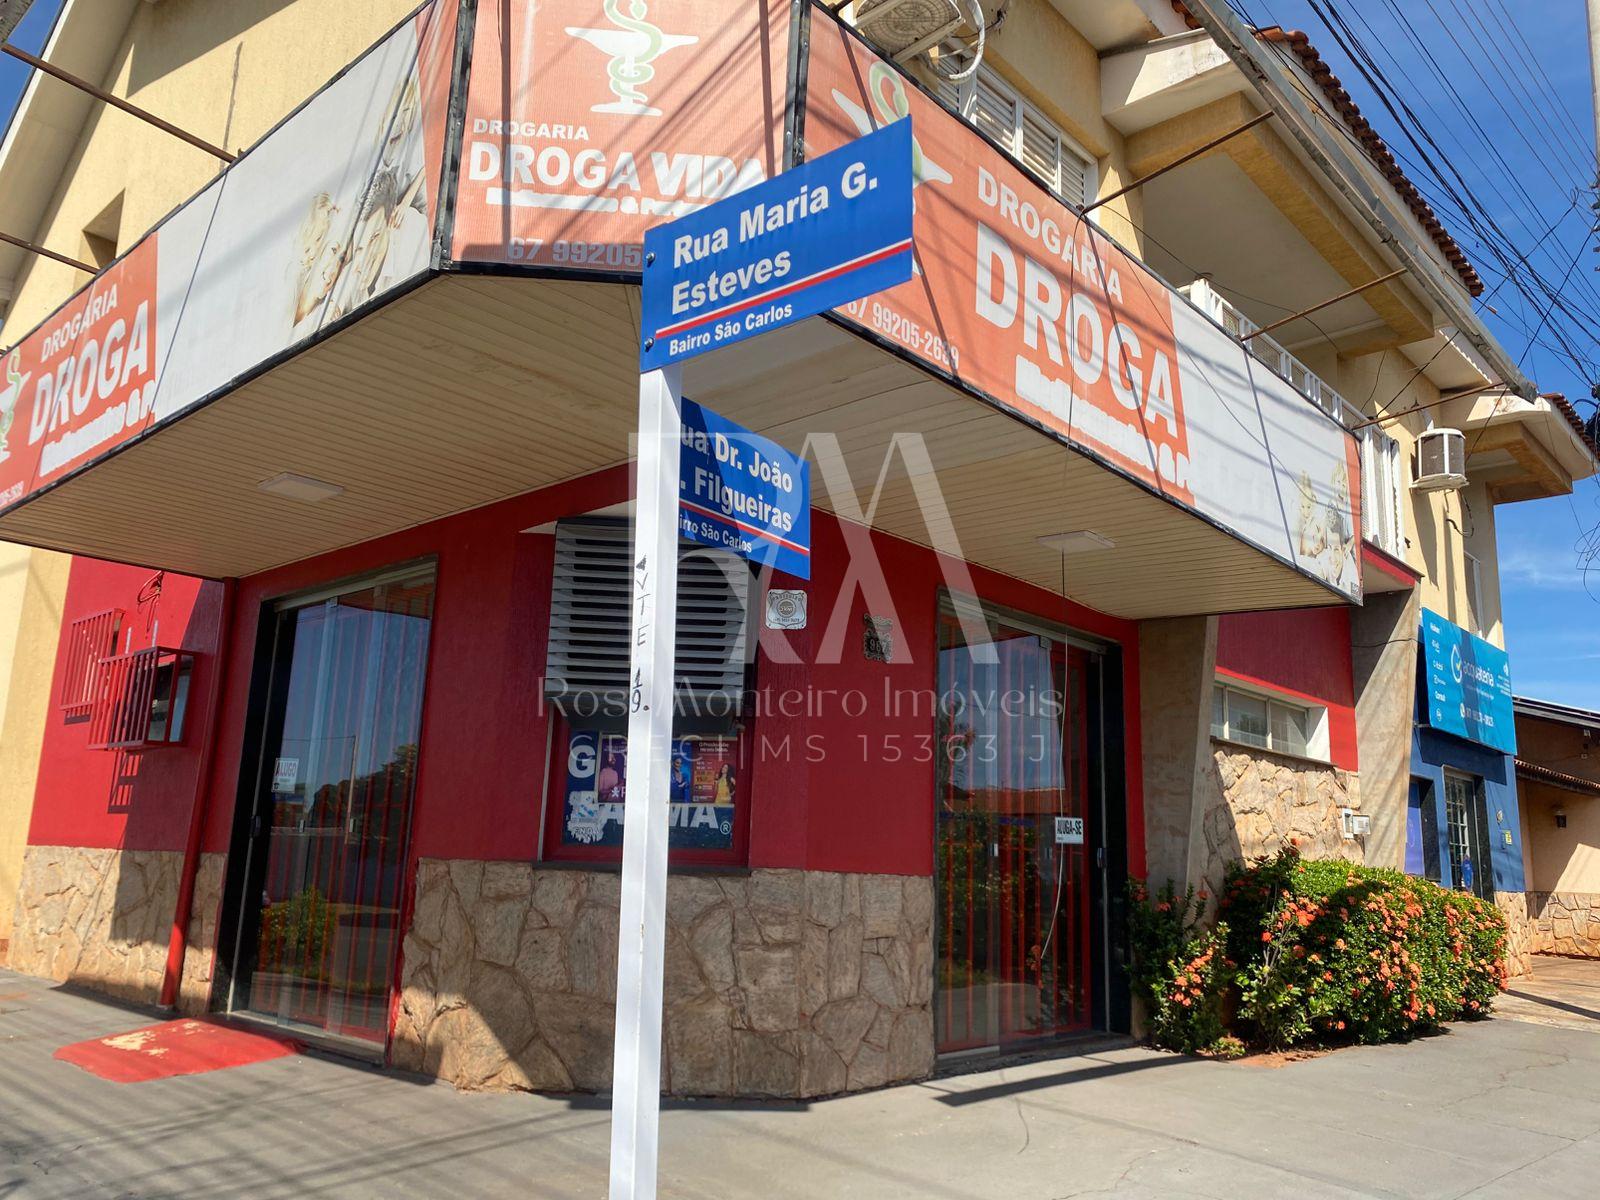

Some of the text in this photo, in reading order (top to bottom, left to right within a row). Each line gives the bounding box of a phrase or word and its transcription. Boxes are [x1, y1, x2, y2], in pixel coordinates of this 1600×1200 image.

[472, 118, 590, 141] DROGARIA
[468, 141, 768, 199] DROGA VIDA
[507, 236, 544, 260] 67
[673, 227, 729, 269] Rua
[739, 185, 829, 244] Maria
[841, 161, 878, 200] G.
[977, 165, 1124, 305] DROGARIA
[671, 250, 792, 315] Esteves
[40, 283, 118, 364] DROGARIA
[669, 303, 793, 357] Bairro São Carlos
[975, 220, 1179, 439] DROGA
[28, 299, 148, 447] DROGA
[681, 422, 793, 494] ua Dr. João
[694, 466, 792, 533] Filgueiras
[679, 514, 752, 553] irro São Carlos
[1057, 819, 1082, 835] ALUGA-SE
